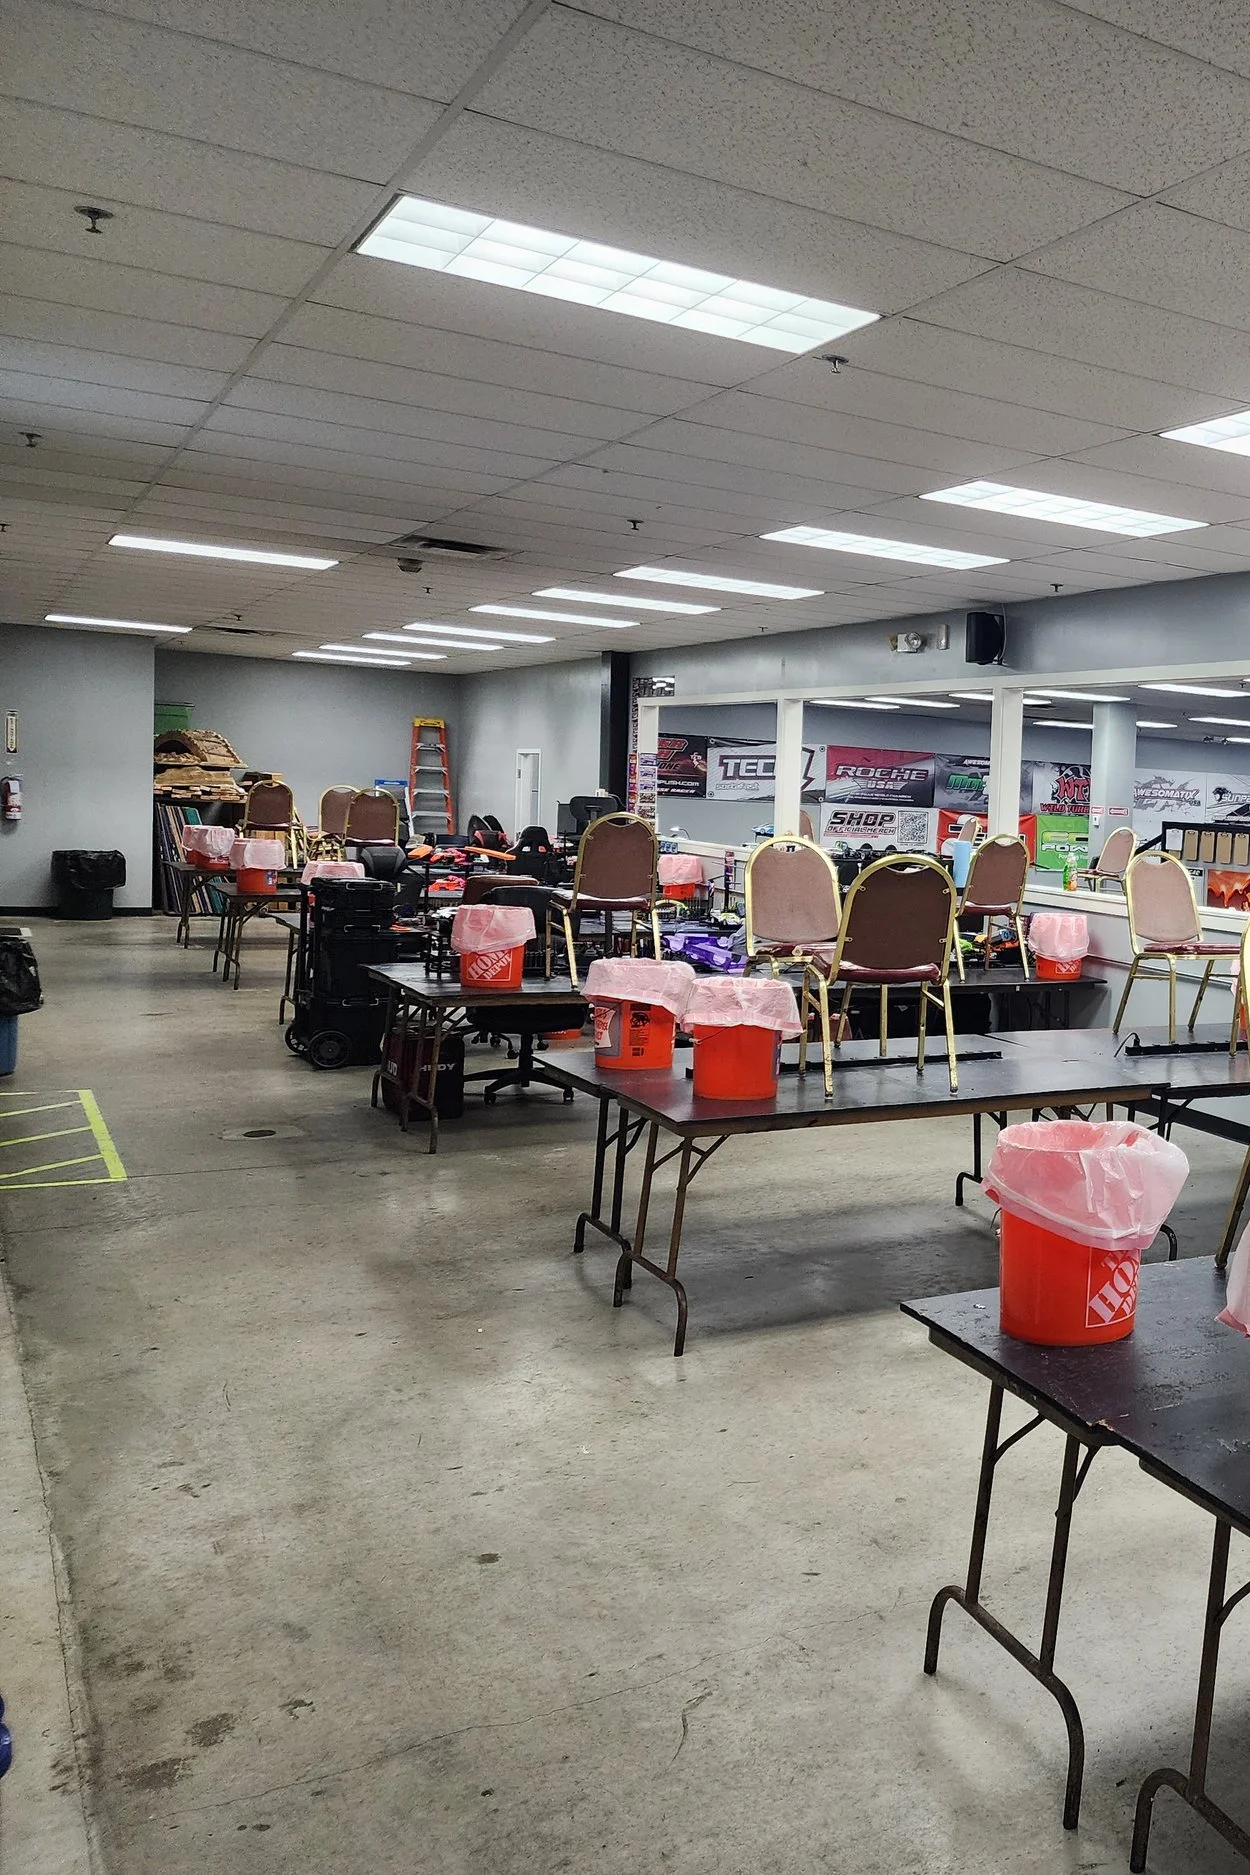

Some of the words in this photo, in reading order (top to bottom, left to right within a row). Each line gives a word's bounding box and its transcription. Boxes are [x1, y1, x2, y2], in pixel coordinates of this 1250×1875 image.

[836, 765, 928, 781] ROCHE
[866, 781, 894, 789] USA
[830, 811, 895, 827] SHOP
[827, 825, 864, 833] OFFICIAL
